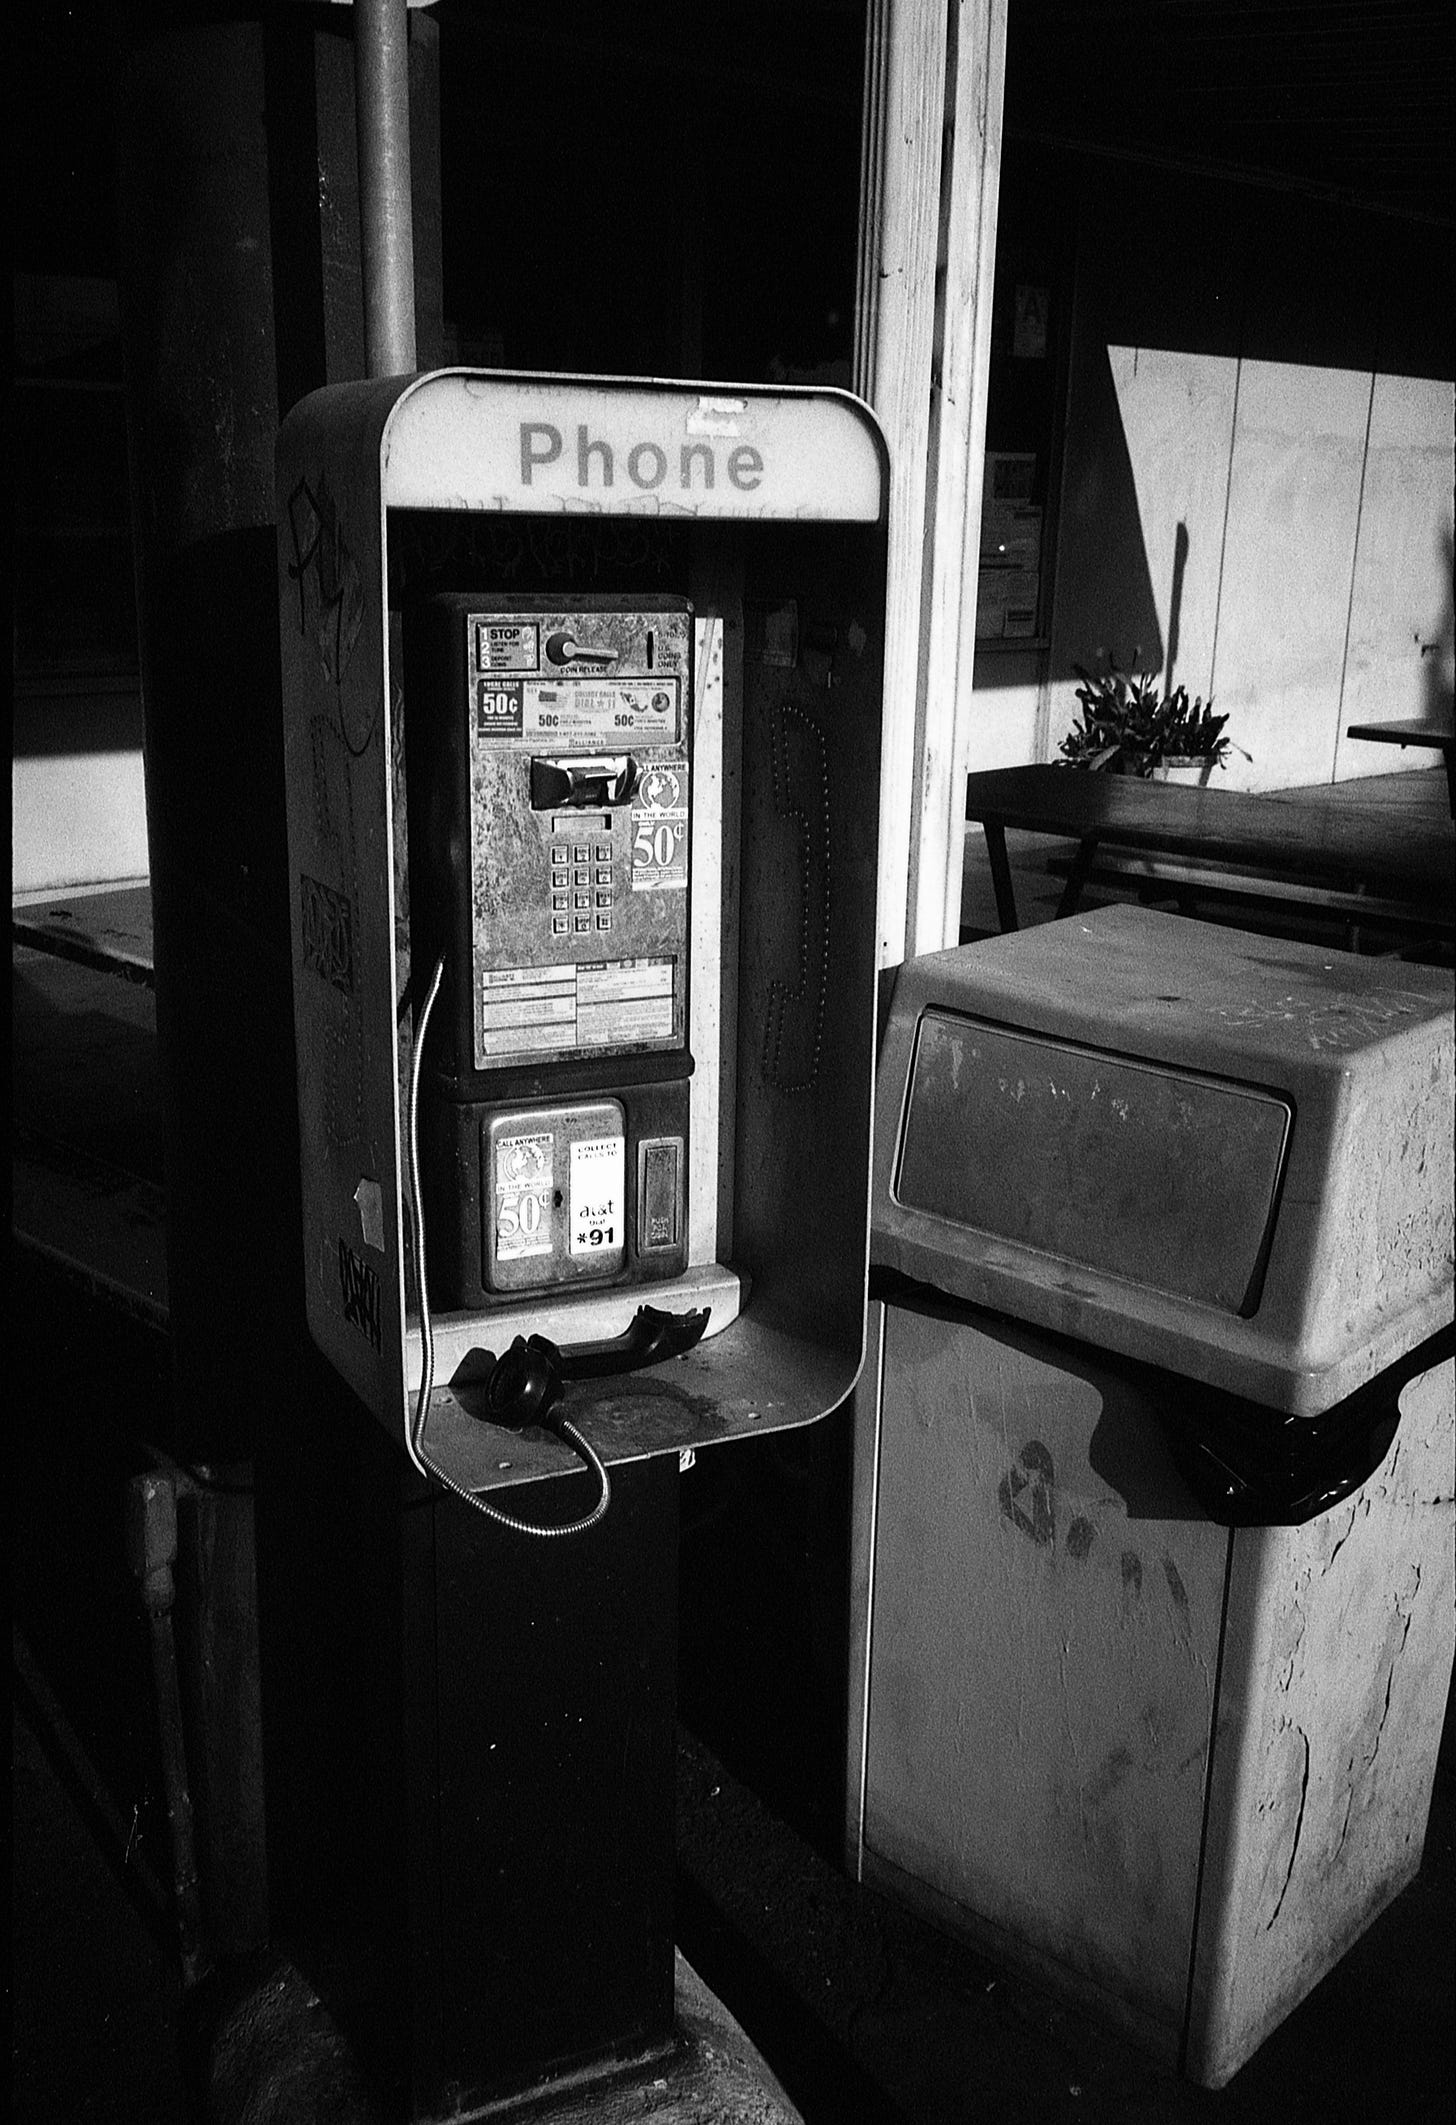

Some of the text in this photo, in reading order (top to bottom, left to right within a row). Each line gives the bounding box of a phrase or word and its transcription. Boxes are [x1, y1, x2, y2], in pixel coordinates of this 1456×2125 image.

[520, 422, 764, 491] Phone
[481, 628, 520, 640] 1 STOP
[481, 641, 490, 654] 2
[481, 655, 490, 668] 3
[560, 666, 578, 674] COIN
[483, 692, 518, 714] 50¢
[651, 763, 686, 771] ANYWHERE
[633, 822, 684, 867] 50¢
[515, 1135, 550, 1145] ANYWHERE
[497, 1191, 550, 1238] 50¢
